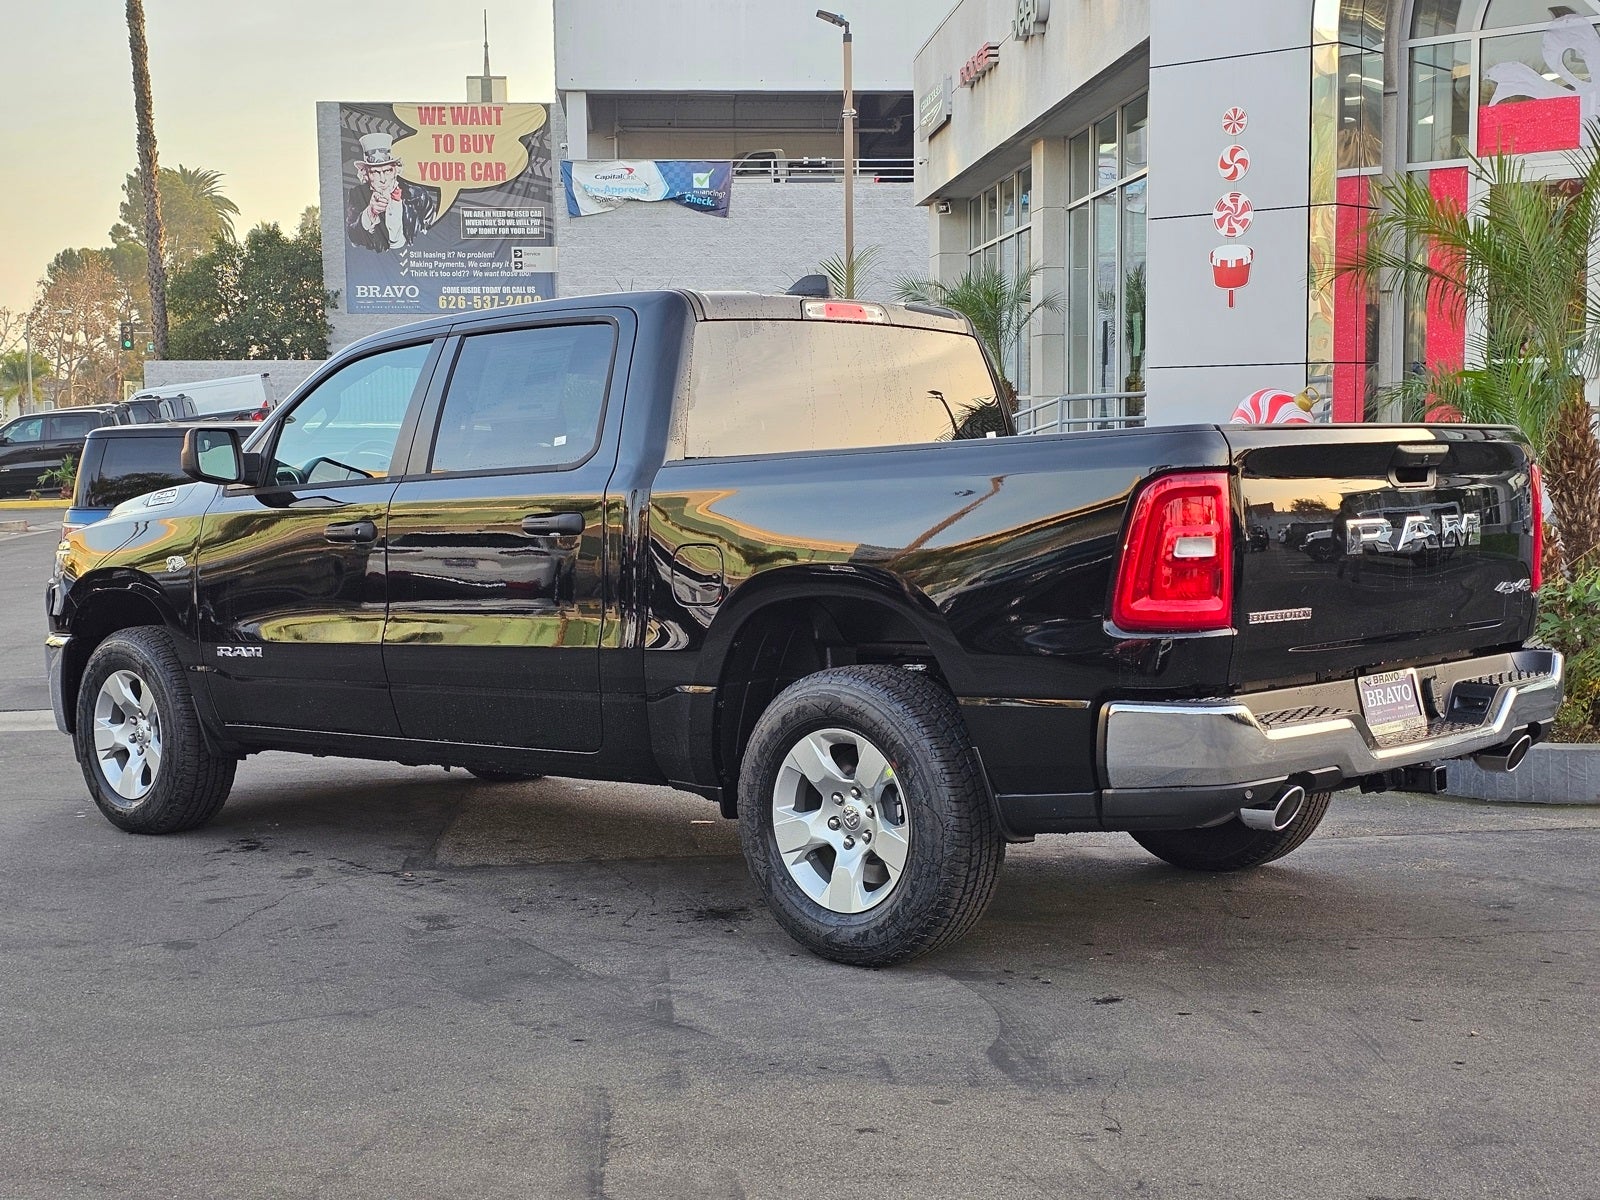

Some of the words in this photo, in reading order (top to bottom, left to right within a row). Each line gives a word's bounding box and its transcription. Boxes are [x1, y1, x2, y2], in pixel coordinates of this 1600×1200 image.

[417, 106, 446, 126] WE
[450, 106, 504, 126] WANT
[432, 133, 455, 154] TO
[460, 133, 495, 154] BUY
[417, 161, 467, 182] YOUR
[470, 161, 507, 182] CAR
[684, 193, 715, 207] Check.
[463, 210, 473, 218] WE
[473, 210, 485, 218] ARE
[485, 210, 492, 218] IN
[492, 210, 506, 218] NEED
[507, 210, 515, 218] OF
[515, 210, 529, 218] USED
[530, 210, 542, 218] CAR
[465, 219, 497, 227] INVENTORY,
[497, 219, 506, 227] SO
[506, 219, 516, 227] WE
[516, 219, 529, 227] WILL
[530, 219, 541, 227] PAY
[423, 251, 447, 260] leasing
[466, 251, 496, 260] problem!
[410, 260, 433, 269] Making
[434, 261, 467, 269] Payments,
[491, 262, 503, 270] pay
[500, 269, 518, 277] those
[355, 285, 420, 298] BRAVO
[442, 286, 460, 294] COME
[460, 286, 481, 294] INSIDE
[482, 286, 501, 294] TODAY
[502, 286, 511, 294] OR
[512, 286, 526, 294] CALL
[527, 286, 536, 294] US
[1345, 512, 1481, 555] RAM
[216, 646, 263, 657] RAM
[1372, 672, 1400, 685] BRAVO
[1364, 683, 1412, 708] BRAVO
